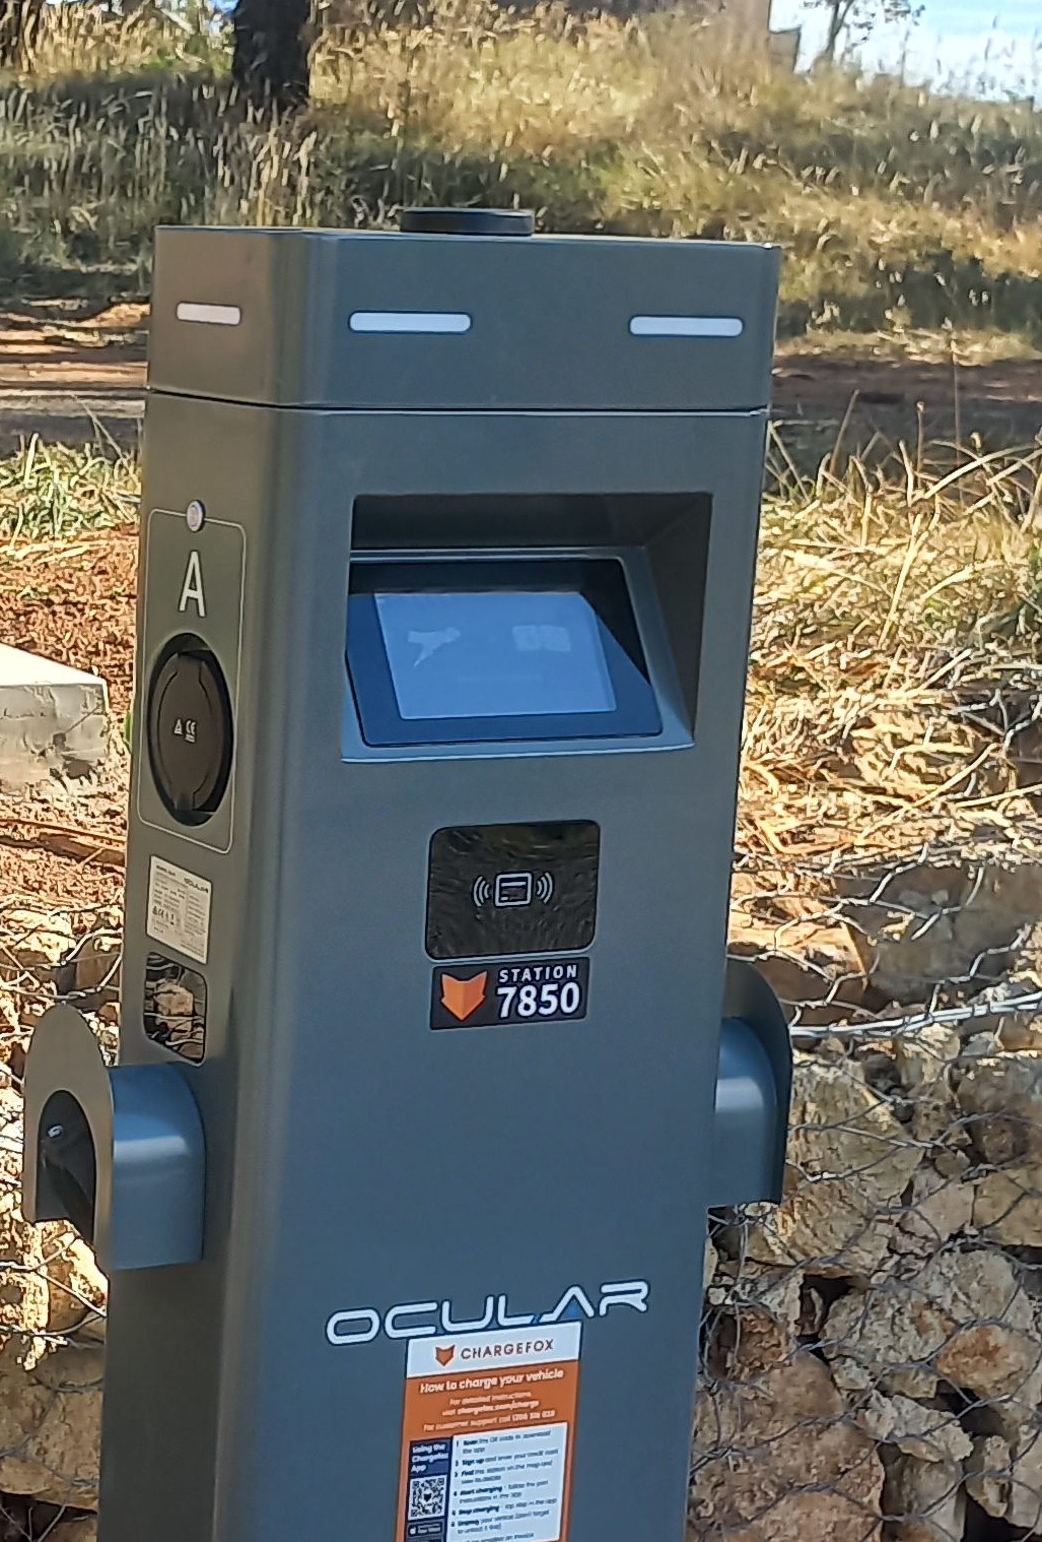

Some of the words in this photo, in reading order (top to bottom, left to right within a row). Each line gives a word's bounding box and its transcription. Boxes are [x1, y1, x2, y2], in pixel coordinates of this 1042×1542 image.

[178, 550, 207, 618] A
[498, 964, 578, 983] STATION
[496, 981, 581, 1019] 7850
[325, 1279, 651, 1347] OCULAR
[461, 1340, 553, 1358] CHARGEFOX
[420, 1383, 443, 1393] How
[446, 1380, 457, 1390] to
[459, 1376, 497, 1391] charge
[500, 1375, 523, 1386] your
[526, 1367, 563, 1381] vehicle
